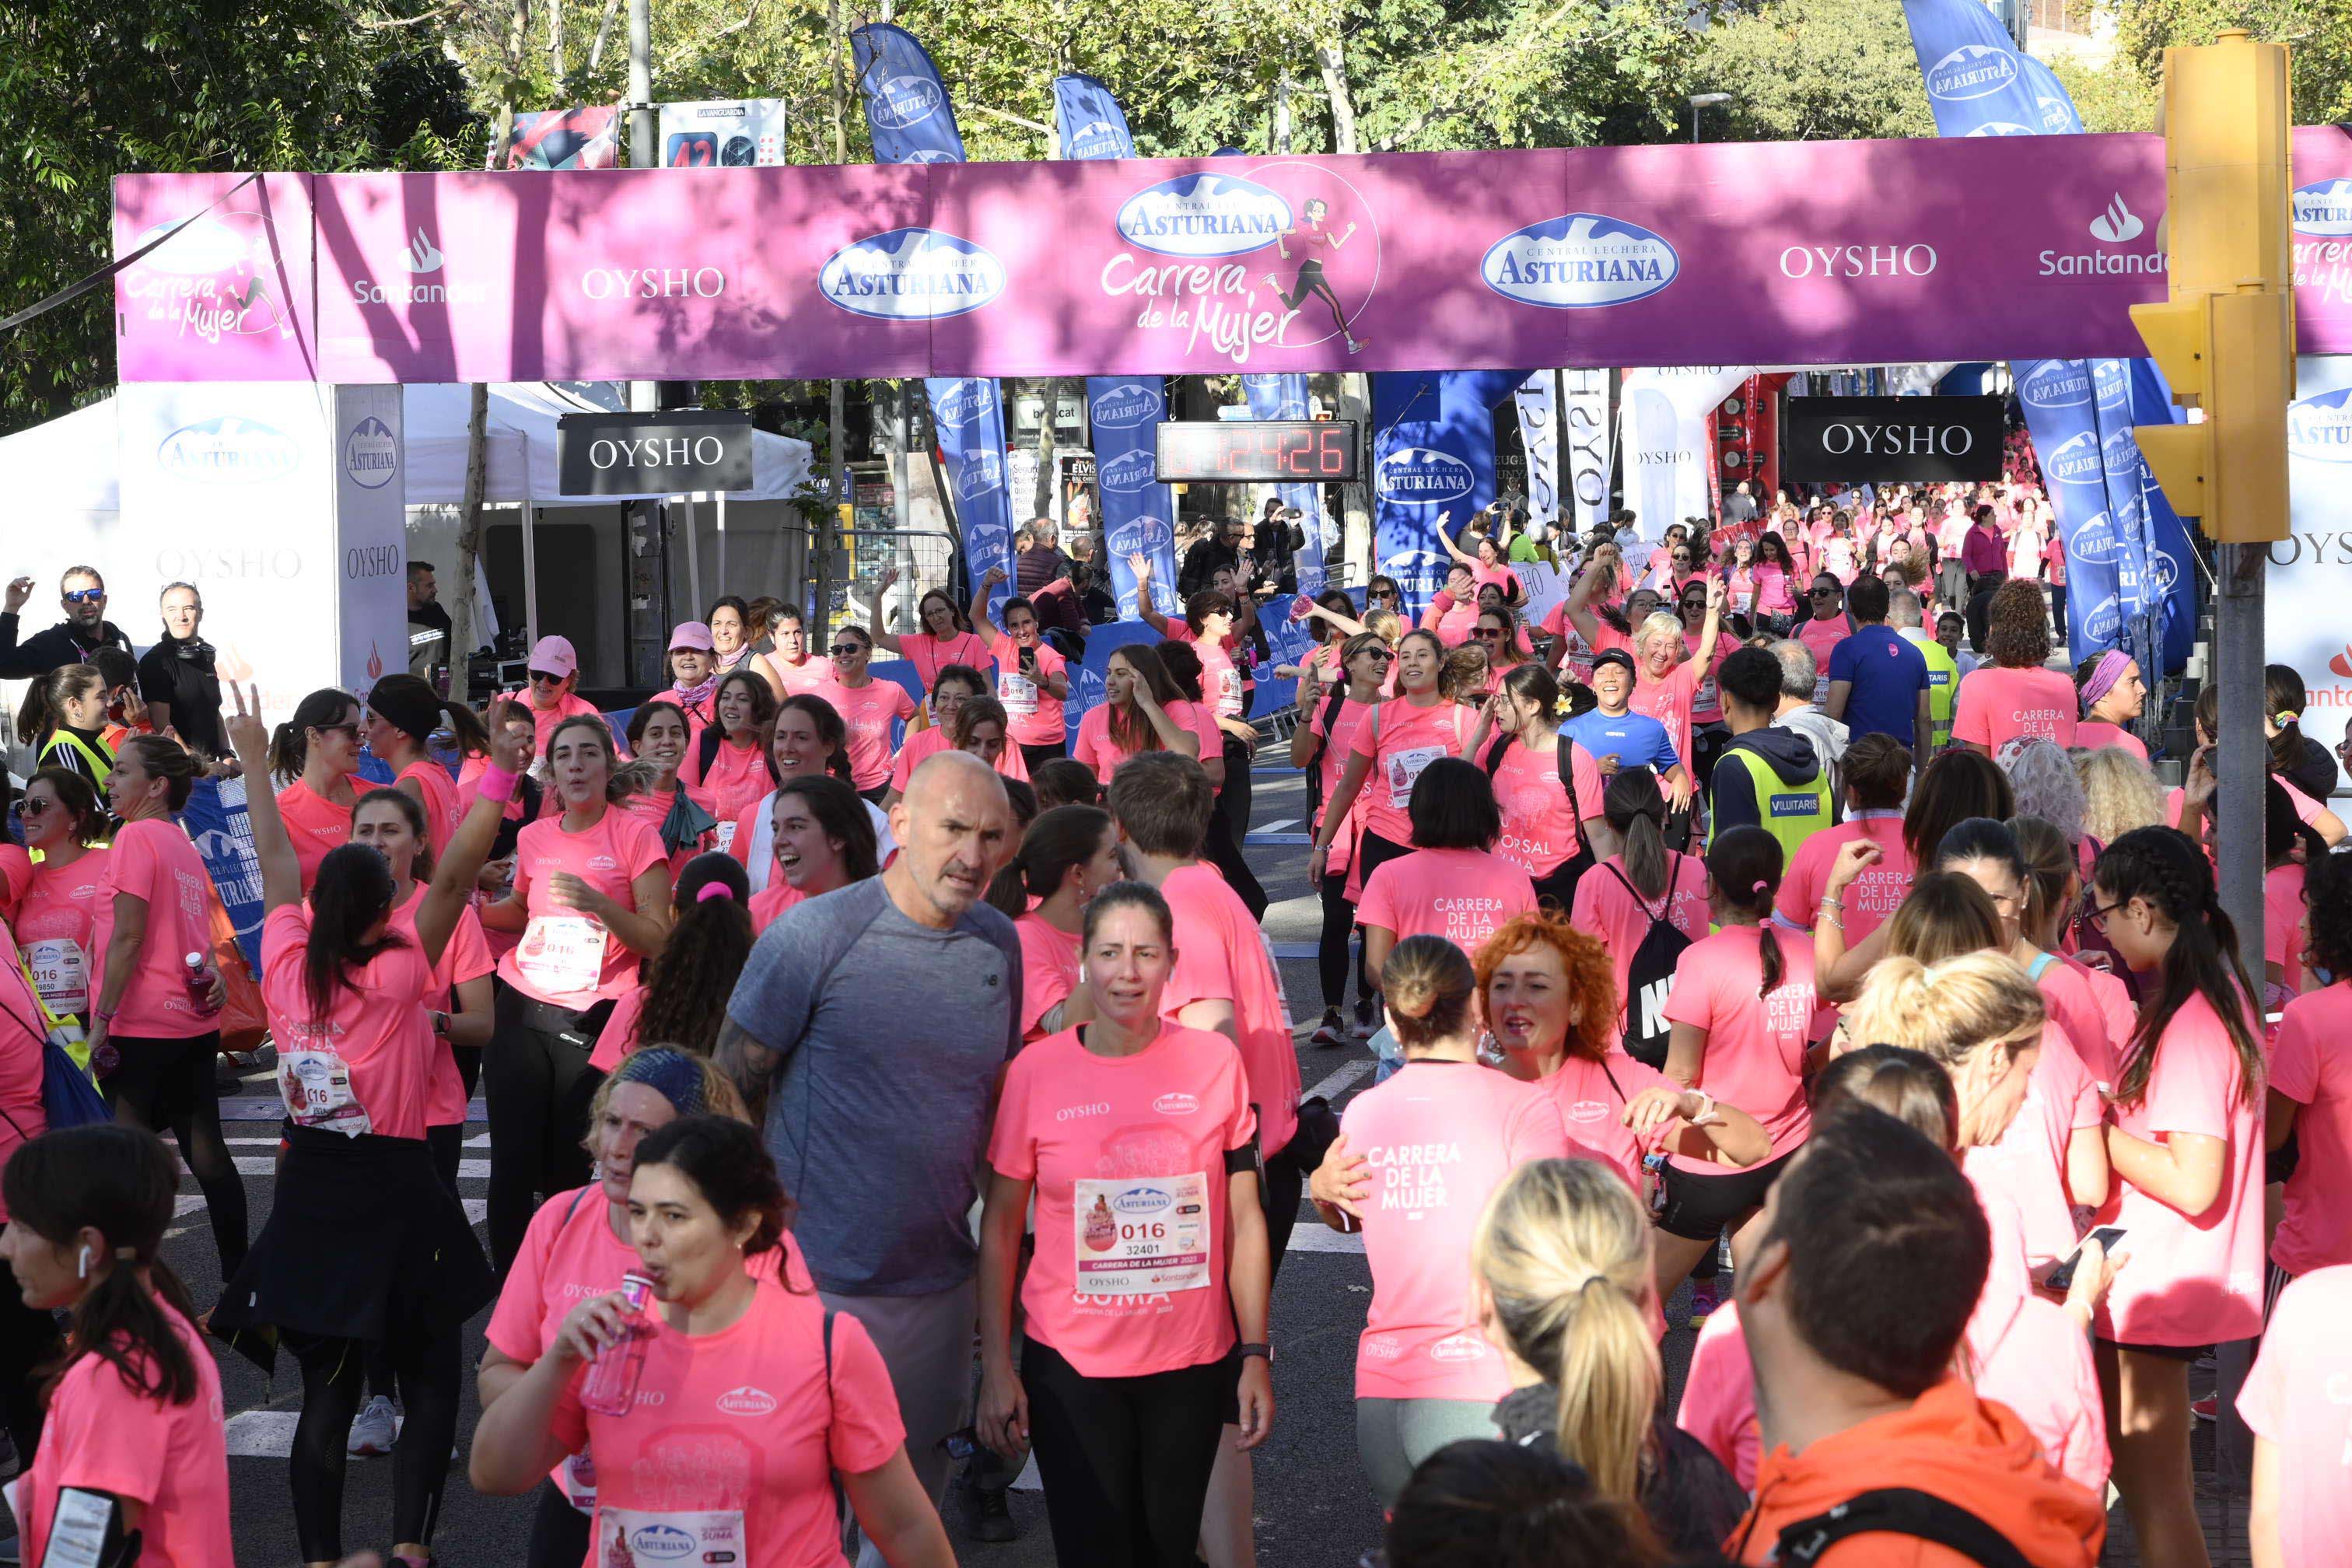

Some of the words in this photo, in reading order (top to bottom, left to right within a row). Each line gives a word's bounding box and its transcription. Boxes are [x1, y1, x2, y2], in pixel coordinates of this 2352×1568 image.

[1129, 205, 1279, 236] ASTURIANA
[1526, 245, 1588, 257] CENTRAL
[1592, 243, 1658, 256] LECHERA
[1496, 250, 1665, 285] ASTURIANA
[1779, 243, 1938, 279] OYSHO
[124, 270, 218, 299] Carrera
[582, 267, 725, 299] OYSHO
[833, 262, 990, 296] ASTURIANA
[1101, 252, 1248, 297] Carrera
[353, 279, 487, 305] Santander
[180, 298, 252, 344] Mujer
[1137, 298, 1164, 330] de
[1170, 296, 1189, 328] la
[1185, 291, 1301, 363] Mujer
[1822, 422, 1972, 456] OYSHO
[349, 443, 394, 471] ASTURIANA
[589, 436, 724, 469] OYSHO
[1633, 449, 1691, 465] OYSHO
[1072, 463, 1097, 474] ELVIS
[1379, 471, 1467, 492] ASTURIANA
[156, 547, 302, 579] OYSHO
[347, 544, 399, 579] OYSHO
[1929, 674, 1948, 684] TARIS
[2012, 709, 2065, 723] CARRERA
[2023, 722, 2038, 733] DE
[2041, 721, 2054, 732] LA
[1772, 796, 1818, 815] VOLUNTARIS
[1500, 834, 1551, 856] ORSAL
[174, 868, 205, 892] CARRERA
[1860, 885, 1878, 898] DE
[1884, 885, 1902, 898] LA
[1433, 898, 1503, 912] CARRERA
[1447, 912, 1468, 926] DE
[1472, 912, 1492, 926] LA
[1444, 926, 1496, 940] MUJER
[33, 969, 58, 982] 016
[1769, 1000, 1787, 1017] DE
[1790, 999, 1805, 1015] LA
[1766, 1015, 1805, 1033] MUJER
[1056, 1102, 1111, 1122] OYSHO
[1368, 1143, 1461, 1167] CARRERA
[1385, 1167, 1412, 1189] DE
[1418, 1164, 1444, 1188] LA
[1119, 1198, 1167, 1208] ASTURIANA
[1381, 1186, 1450, 1211] MUJER
[1122, 1223, 1165, 1240] 016
[1126, 1244, 1160, 1255] 32401
[1092, 1261, 1128, 1270] CARRERA
[1129, 1259, 1140, 1268] DE
[1153, 1257, 1178, 1266] MUJER
[1089, 1277, 1129, 1287] OYSHO
[1160, 1272, 1199, 1283] Santander
[637, 1537, 691, 1551] ASTURIANA
